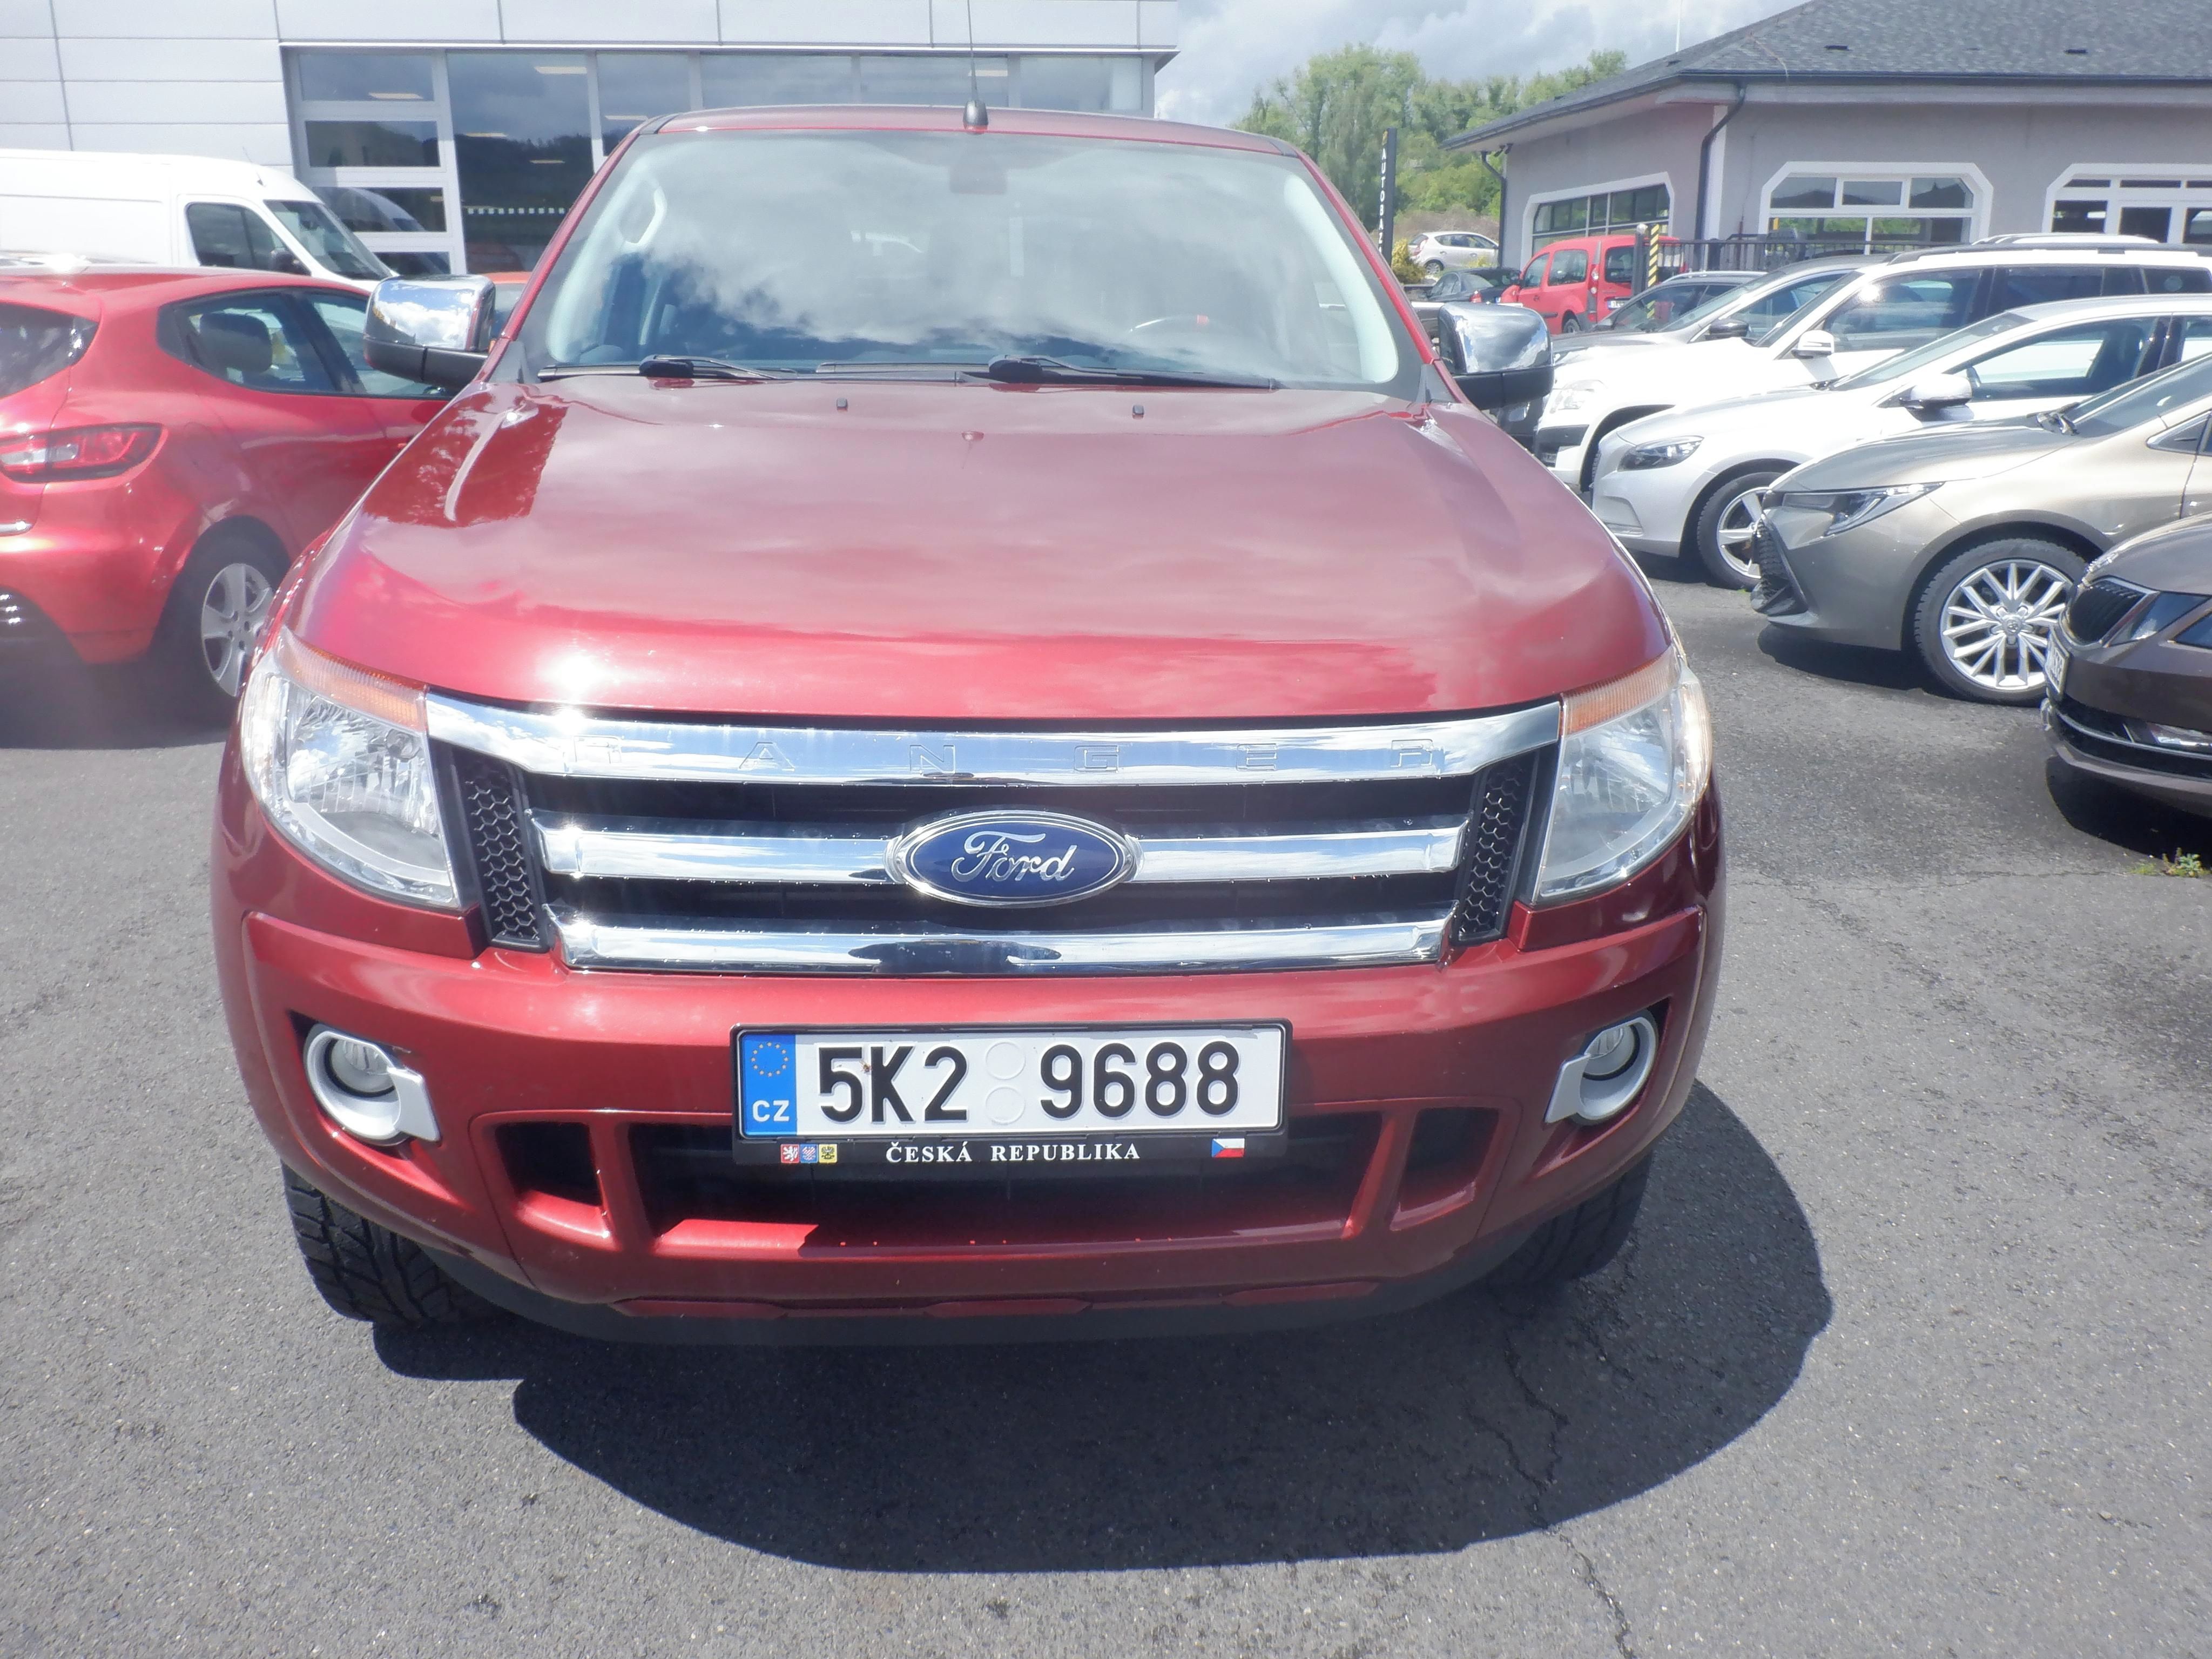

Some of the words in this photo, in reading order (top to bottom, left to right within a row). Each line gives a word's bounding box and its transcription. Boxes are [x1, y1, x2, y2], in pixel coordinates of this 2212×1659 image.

[572, 734, 1433, 773] RANGER
[951, 831, 1078, 882] Ford
[819, 1046, 968, 1123] 5K2
[1040, 1040, 1240, 1118] 9688
[752, 1100, 790, 1122] CZ
[886, 1142, 973, 1163] ČESKÁ
[990, 1143, 1141, 1161] REPUBLIKA
